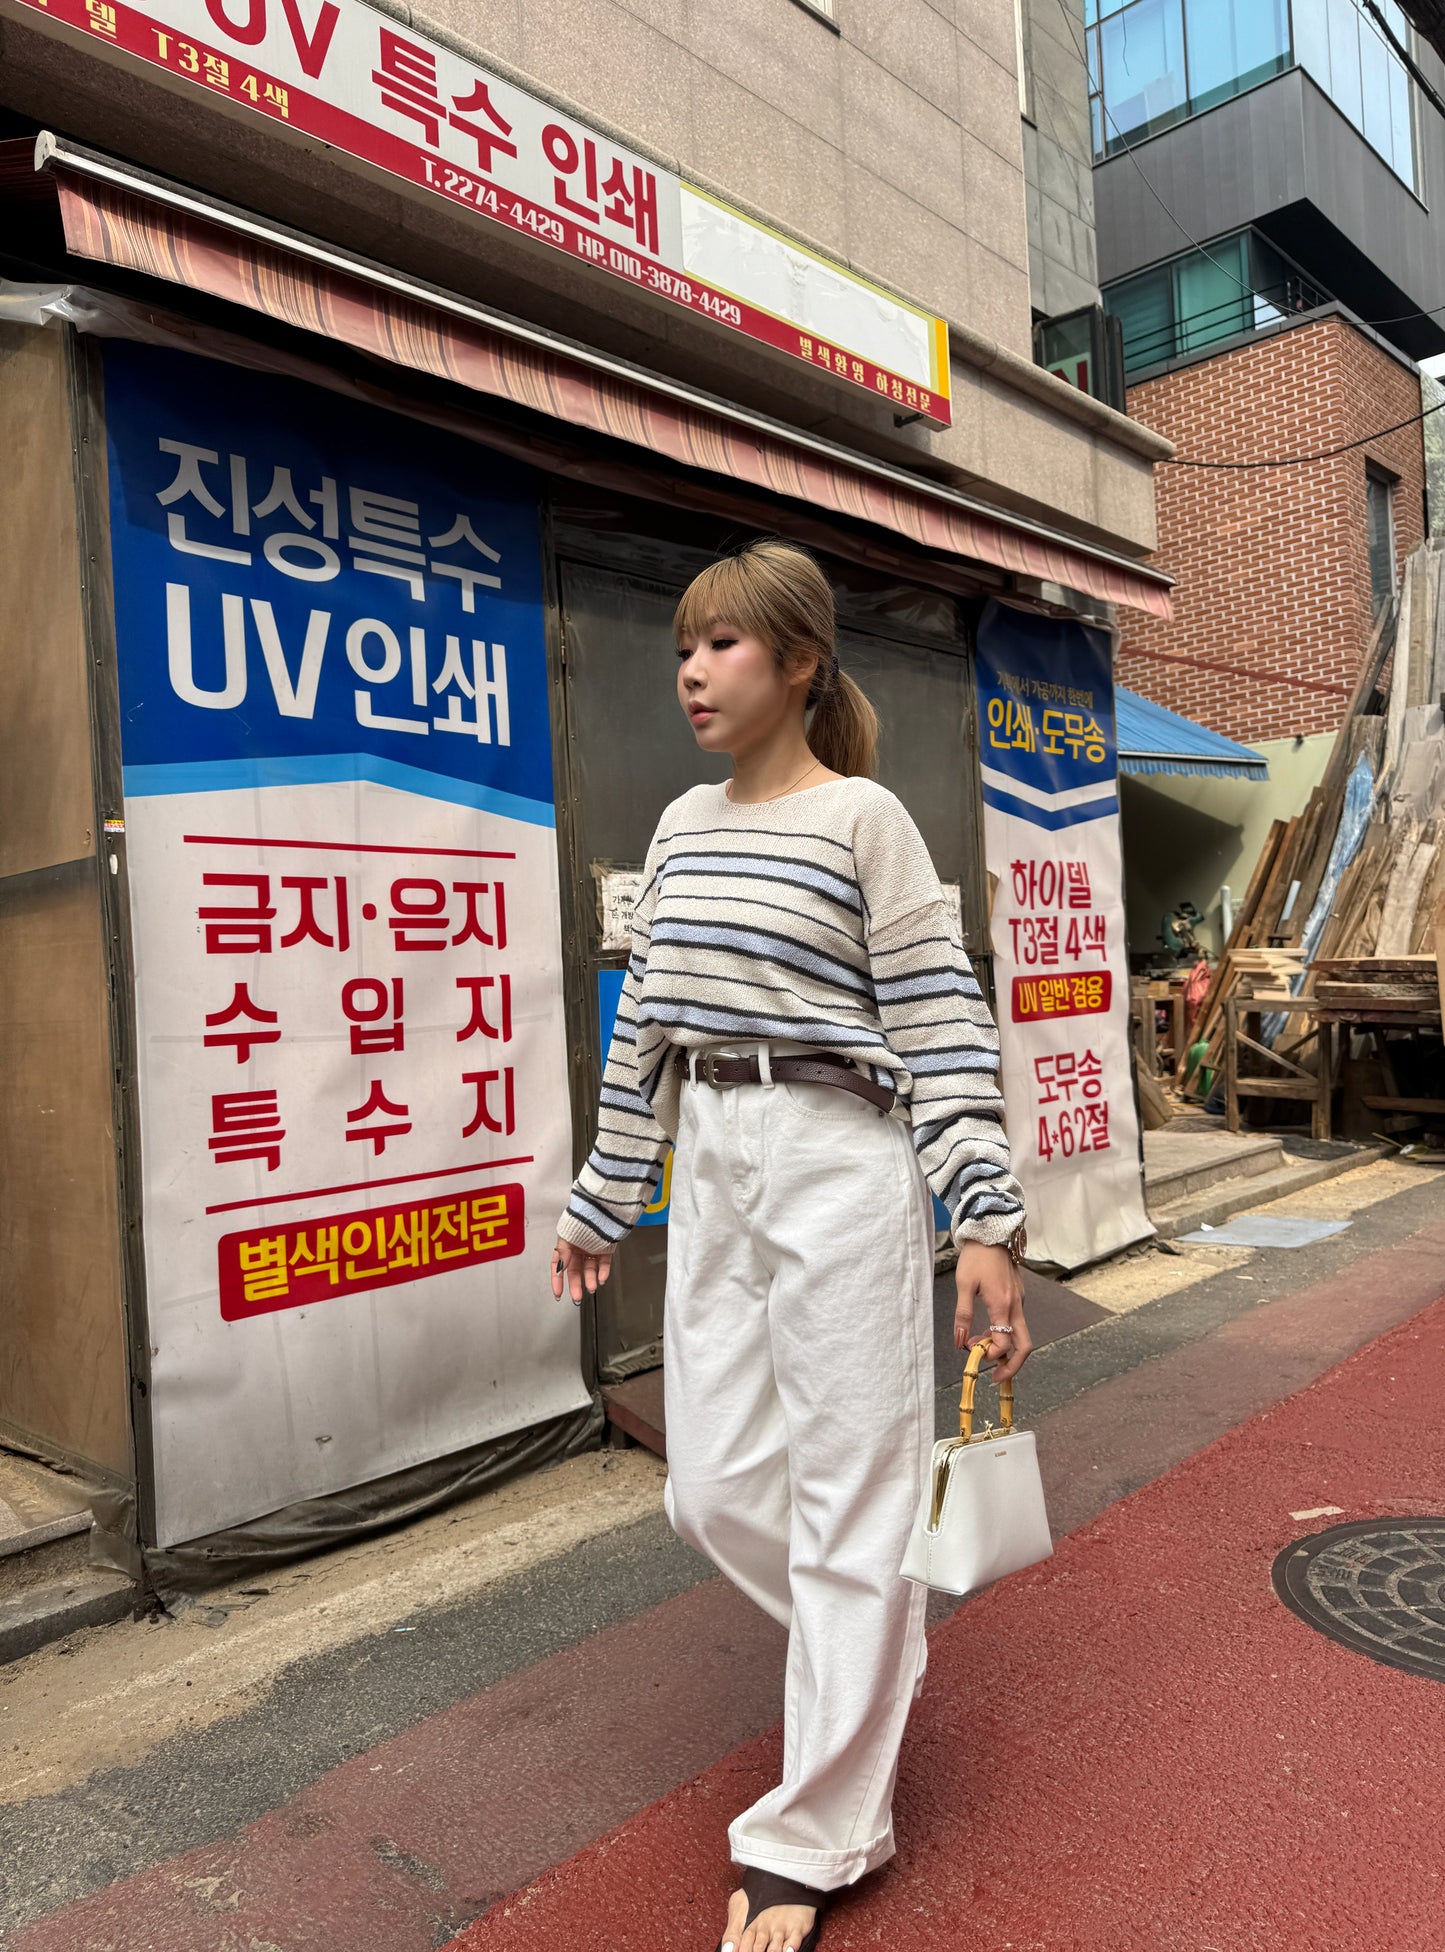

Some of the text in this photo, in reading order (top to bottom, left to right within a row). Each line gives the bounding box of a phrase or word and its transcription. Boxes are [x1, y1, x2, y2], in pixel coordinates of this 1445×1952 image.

[151, 28, 230, 92] T3절
[240, 74, 289, 119] 4색
[371, 26, 516, 174] 특수
[541, 123, 660, 256] 인쇄
[420, 156, 742, 326] T.2274-4429 HP.010-3878-4429
[156, 437, 502, 614] 진성특수
[1010, 858, 1092, 910] 하이델
[1008, 914, 1107, 966] T3절 4색
[1034, 1049, 1103, 1105] 도무송
[239, 1194, 509, 1302] 별색인쇄전문
